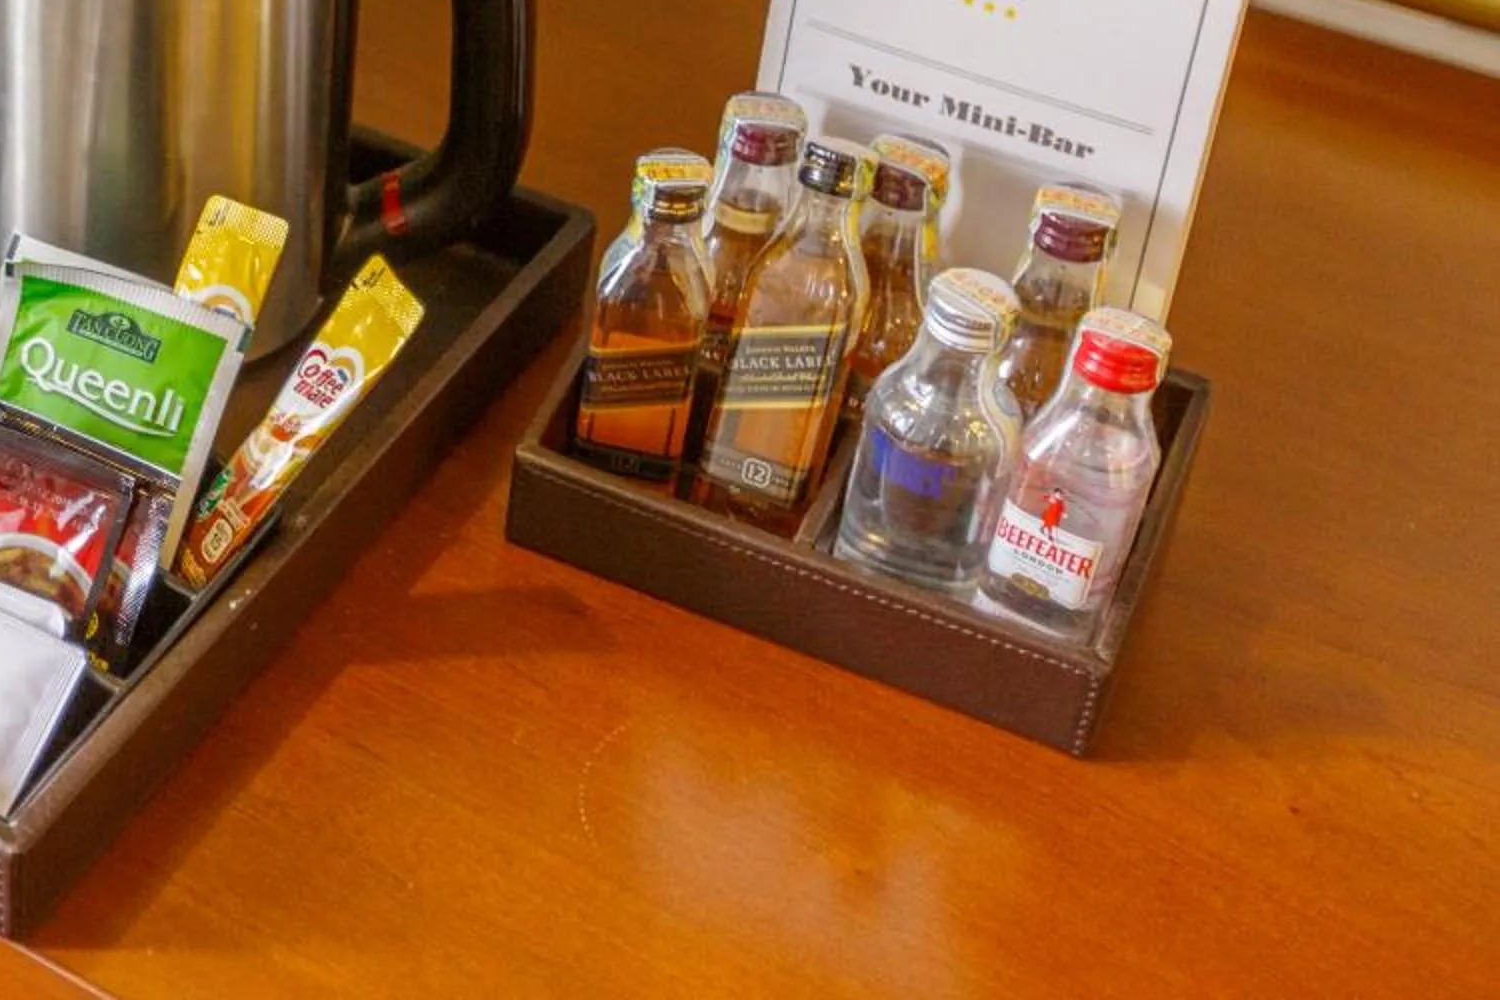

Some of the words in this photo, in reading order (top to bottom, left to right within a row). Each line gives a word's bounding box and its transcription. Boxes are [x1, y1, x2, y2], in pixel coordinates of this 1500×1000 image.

[849, 63, 931, 107] Your
[940, 93, 1095, 159] Mini-Bar
[20, 336, 186, 433] Queenli
[297, 348, 345, 396] Coffee
[746, 462, 767, 484] 12
[996, 516, 1093, 579] BEEFEATER
